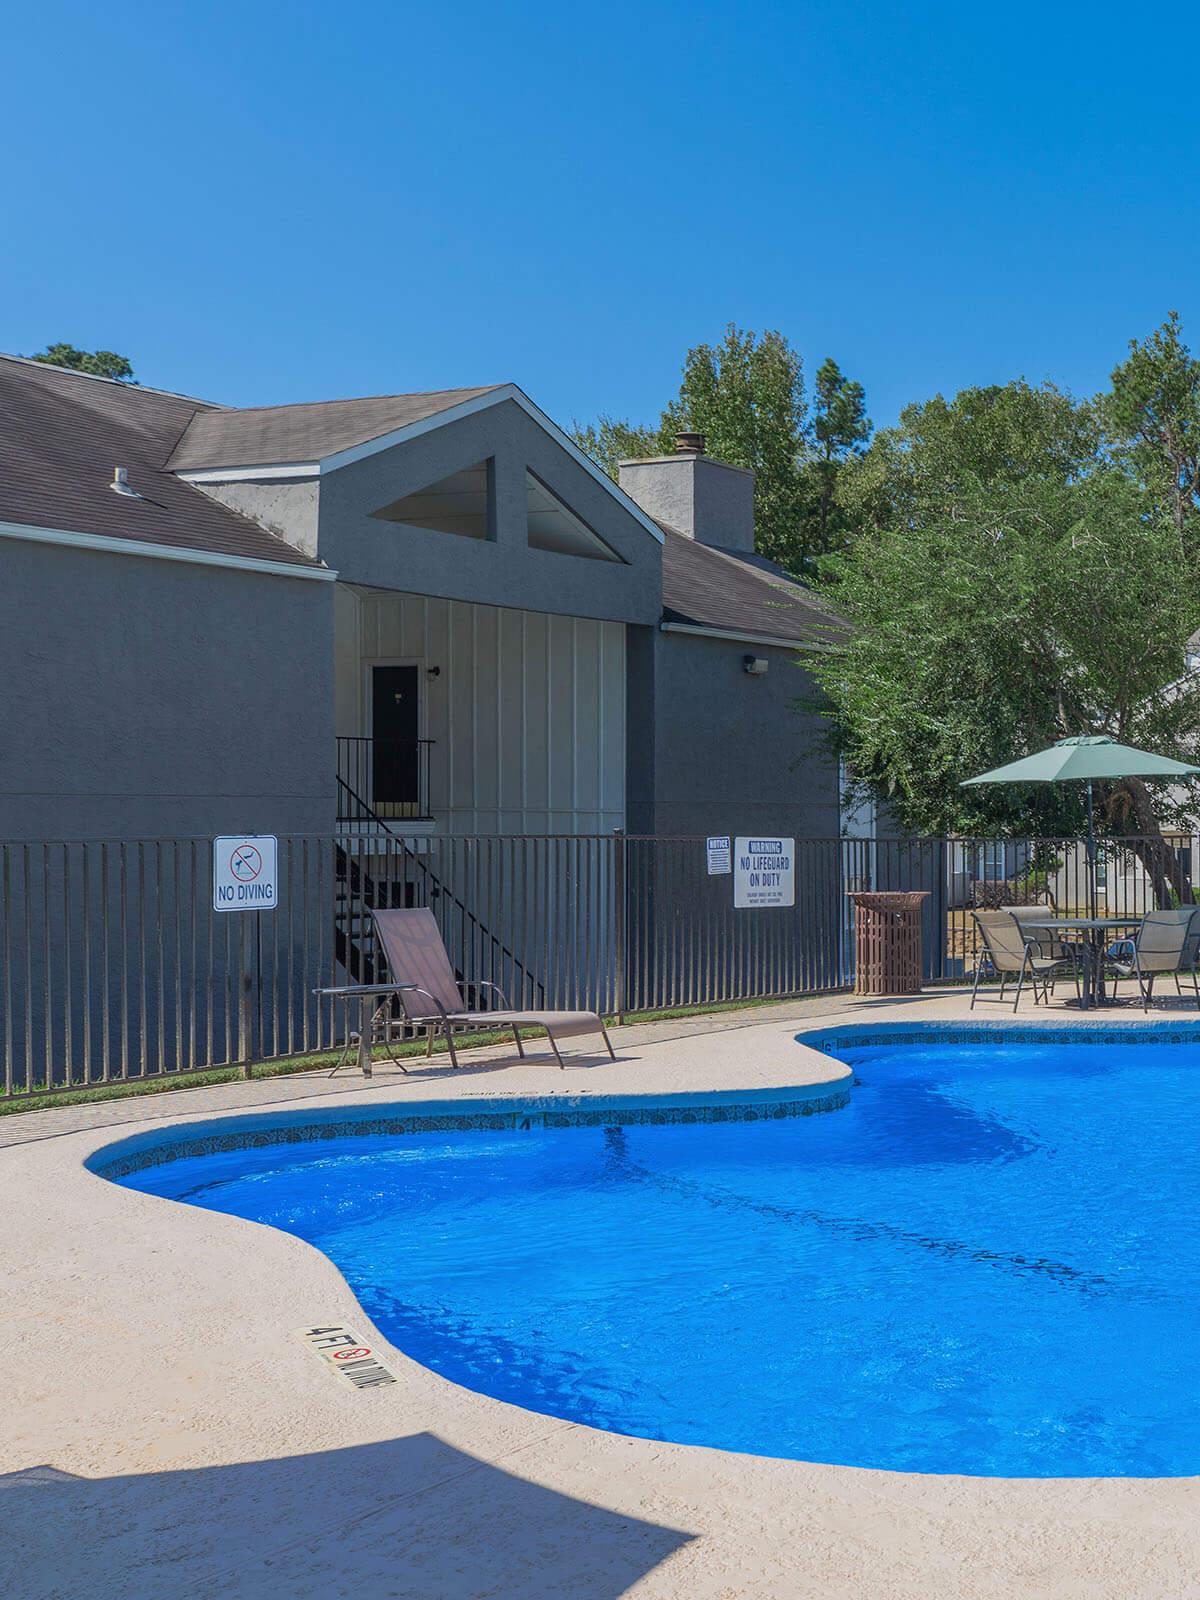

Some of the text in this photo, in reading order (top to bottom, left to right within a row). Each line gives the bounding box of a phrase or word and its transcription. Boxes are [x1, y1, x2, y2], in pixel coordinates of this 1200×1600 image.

[709, 839, 729, 849] NOTICE
[750, 842, 781, 853] WARNING
[740, 856, 751, 870] NO
[753, 856, 790, 870] LIFEGUARD
[749, 872, 780, 887] ON DUTY
[218, 883, 273, 901] NO DIVING
[305, 1327, 344, 1337] 4
[311, 1334, 358, 1350] FT
